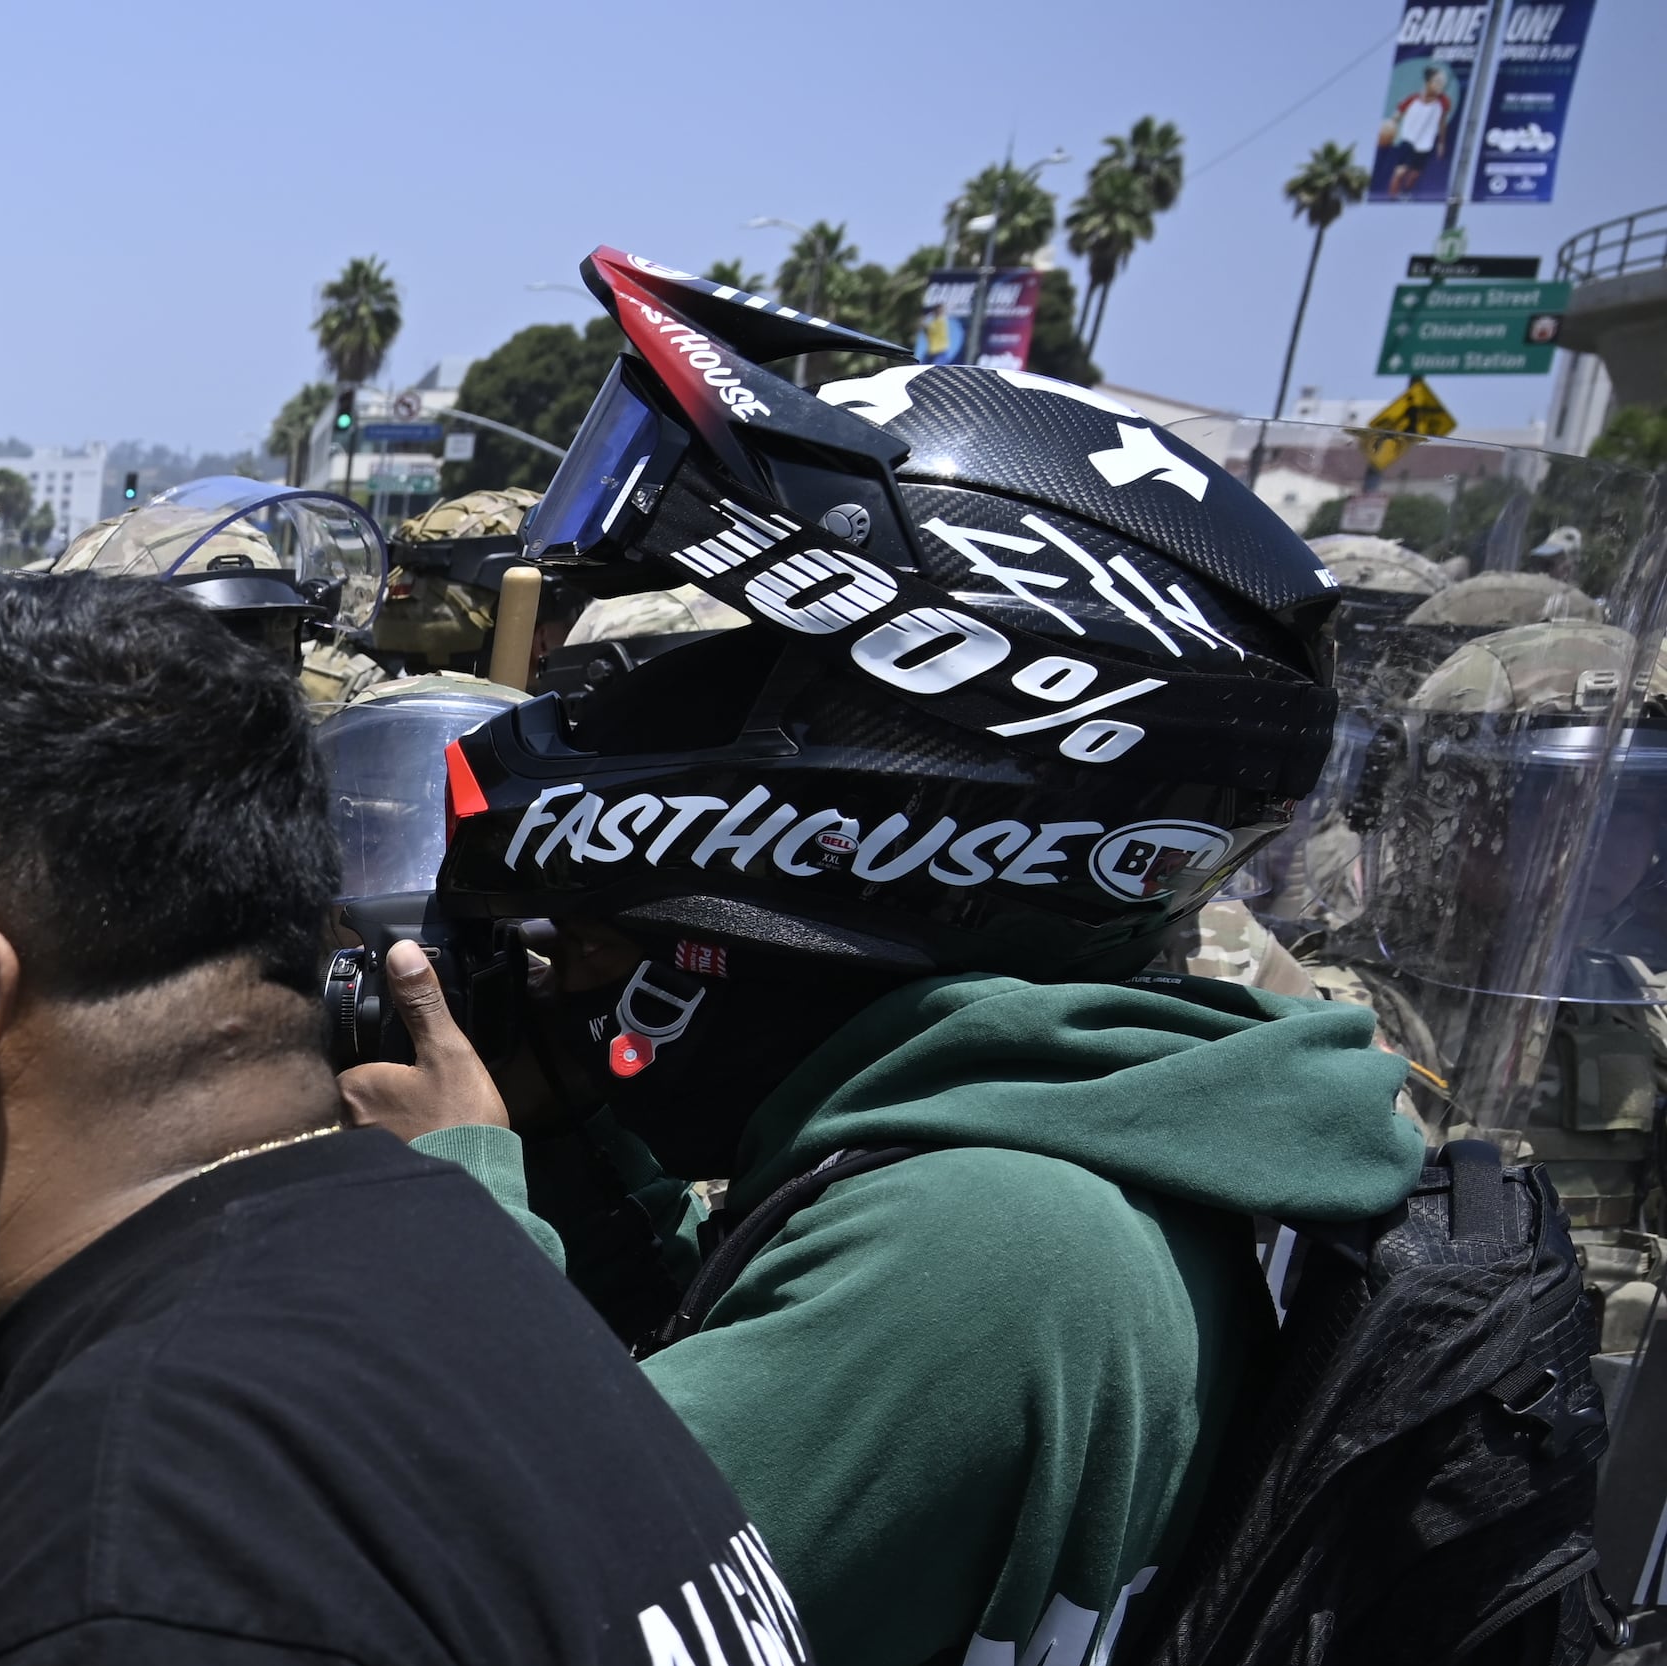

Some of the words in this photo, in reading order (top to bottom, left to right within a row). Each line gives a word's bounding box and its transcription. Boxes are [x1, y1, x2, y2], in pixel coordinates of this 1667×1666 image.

[1398, 5, 1488, 44] GAME
[1506, 4, 1565, 42] ON!
[1486, 288, 1540, 306] Street
[1419, 322, 1507, 340] Chinatown
[617, 293, 771, 424] STHOUSE
[1411, 353, 1460, 370] Union
[1465, 353, 1527, 370] Station
[670, 498, 1170, 764] 100%
[504, 782, 1104, 887] FASTHOUSE
[822, 835, 851, 850] BELL
[822, 853, 840, 865] XXL
[698, 946, 713, 974] PULL
